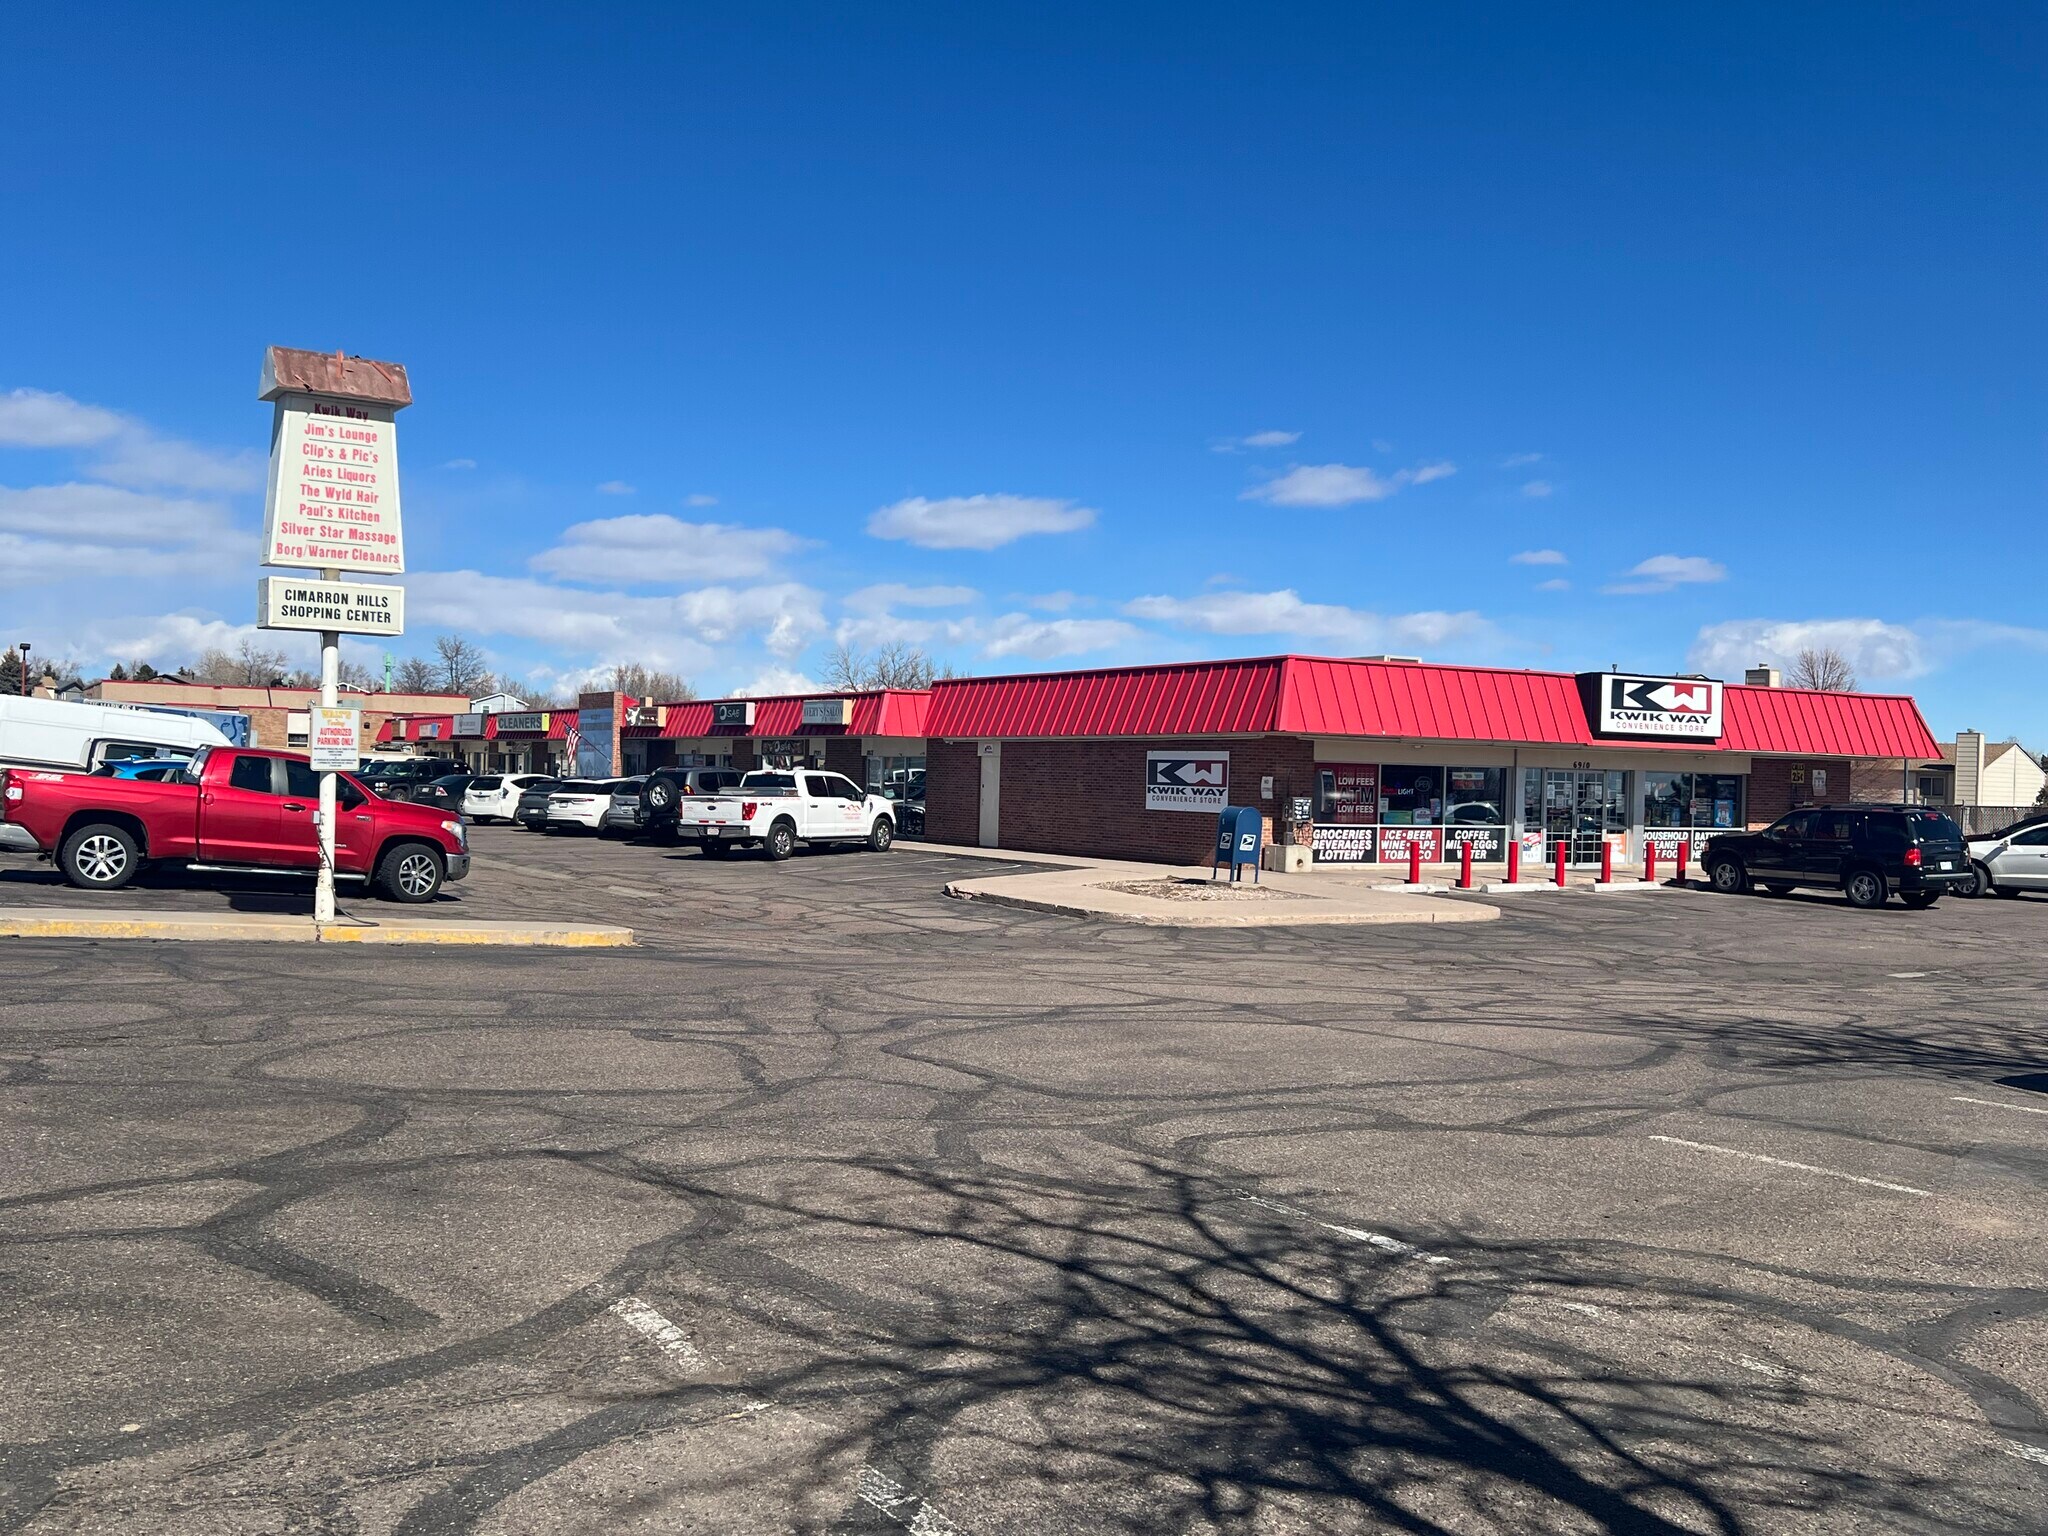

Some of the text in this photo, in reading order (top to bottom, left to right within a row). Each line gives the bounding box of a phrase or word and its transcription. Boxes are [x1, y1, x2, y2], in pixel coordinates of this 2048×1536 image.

[314, 403, 369, 422] Kwik Way
[303, 423, 378, 443] Jim's Lounge
[302, 443, 379, 464] Clip's & Pic's
[302, 464, 376, 484] Aries Liquors
[300, 484, 379, 504] The Wyld Hair
[299, 504, 380, 523] Paul's Kitchen
[281, 522, 396, 545] Silver Star Massage
[276, 543, 400, 564] Borg/Warner Cleaners
[285, 589, 388, 608] CIMARRON HILLS
[281, 605, 391, 623] SHOPPING CENTER
[499, 716, 541, 729] CLEANERS
[1610, 711, 1711, 724] KWIK WAY
[320, 728, 352, 737] AUTHORIZED
[1616, 721, 1705, 733] CONVENIENCE STORE
[317, 737, 354, 746] PARKING ONLY
[1573, 761, 1591, 769] 6910
[1337, 777, 1375, 786] LOW FEES
[1147, 786, 1227, 797] KWIK WAY
[1337, 786, 1375, 804] ATM
[1151, 795, 1197, 803] CONVENIENCE
[1337, 804, 1374, 814] LOW FEES
[1312, 829, 1372, 840] GROCERIES
[1454, 829, 1490, 840] COFFEE
[1312, 839, 1372, 850] BEVERAGES
[1445, 840, 1463, 850] MIL
[1318, 849, 1365, 860] LOTTERY
[1384, 849, 1432, 860] TOBACO
[1456, 849, 1487, 859] WTER
